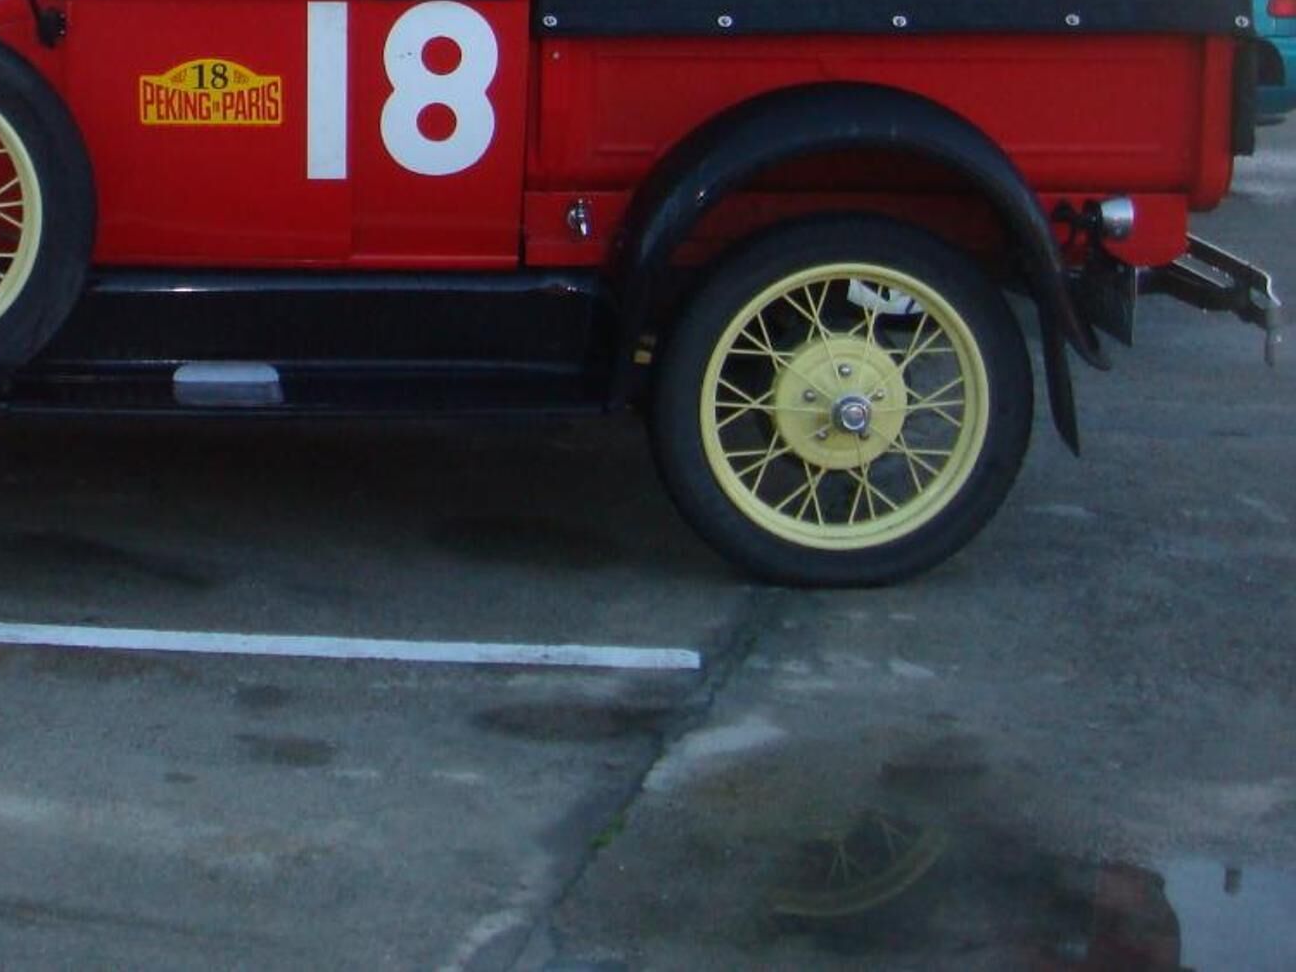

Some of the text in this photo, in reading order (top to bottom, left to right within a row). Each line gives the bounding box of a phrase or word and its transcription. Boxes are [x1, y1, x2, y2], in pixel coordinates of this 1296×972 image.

[191, 63, 229, 89] 18
[307, 0, 499, 179] 18
[144, 80, 280, 120] PEKING PARIS
